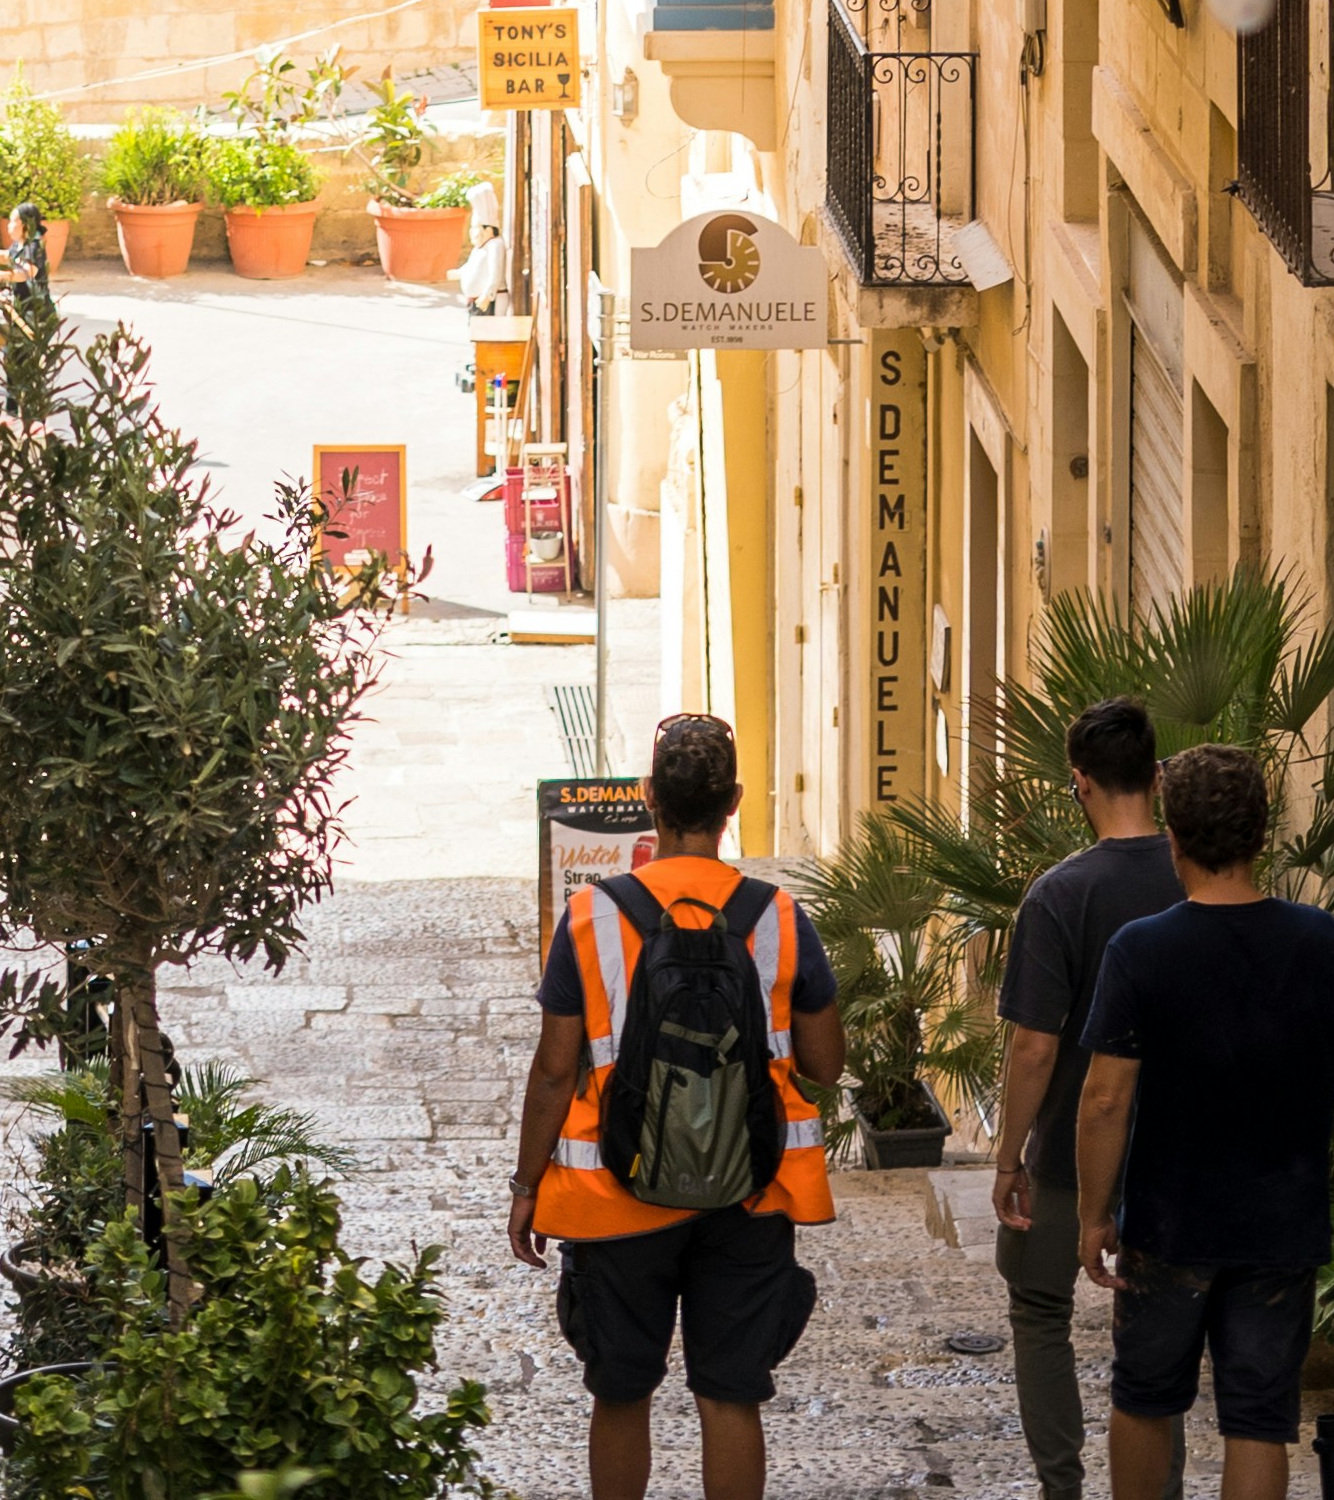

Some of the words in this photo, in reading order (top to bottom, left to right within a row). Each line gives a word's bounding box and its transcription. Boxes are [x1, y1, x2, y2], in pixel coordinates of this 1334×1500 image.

[493, 23, 567, 41] TONY'S
[493, 51, 569, 68] SICILIA
[506, 78, 545, 94] BAR
[640, 302, 817, 323] S.DEMANUELE
[877, 404, 905, 802] DEMANUELE
[560, 785, 648, 803] S.DEMANU
[567, 804, 645, 814] WATCHMAK
[553, 843, 621, 869] Watch
